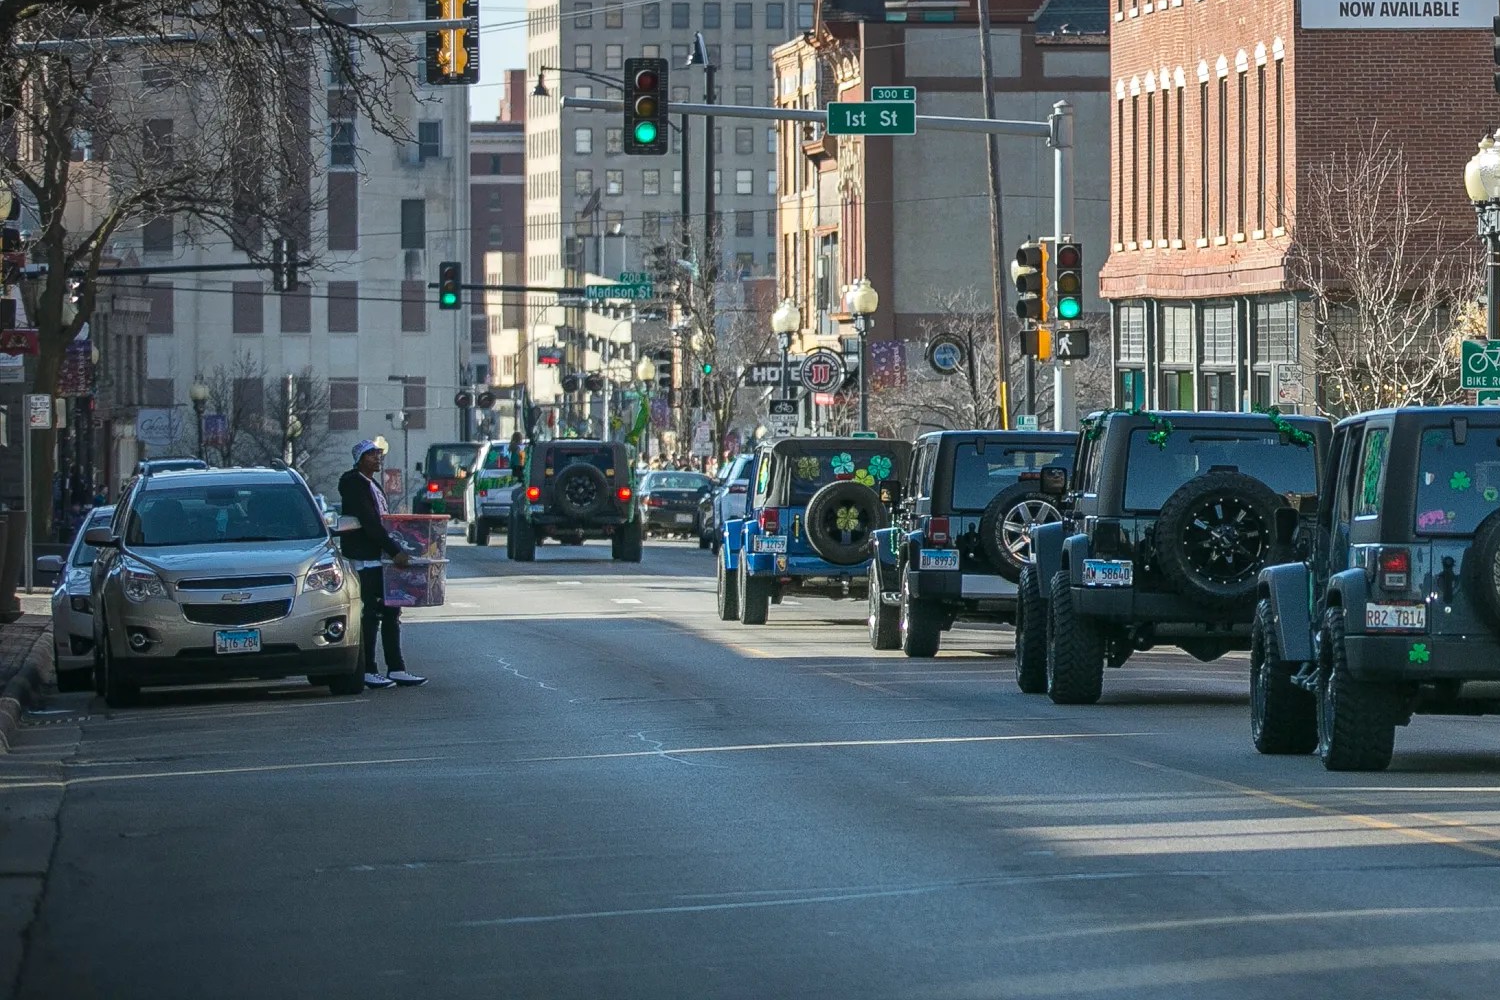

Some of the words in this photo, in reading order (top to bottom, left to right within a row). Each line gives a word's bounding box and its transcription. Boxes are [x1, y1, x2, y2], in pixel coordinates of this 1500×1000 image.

[1340, 1, 1376, 18] NOW
[1379, 1, 1460, 18] AVAILABLE
[878, 90, 898, 99] 300
[903, 90, 910, 99] E
[845, 110, 867, 127] 1st
[879, 110, 898, 127] St
[588, 285, 634, 299] Madison
[638, 285, 651, 299] St
[1466, 376, 1488, 387] BIKE
[1101, 567, 1130, 580] 58640
[1367, 610, 1389, 626] R82
[1394, 610, 1424, 627] 7814
[243, 636, 258, 648] 284
